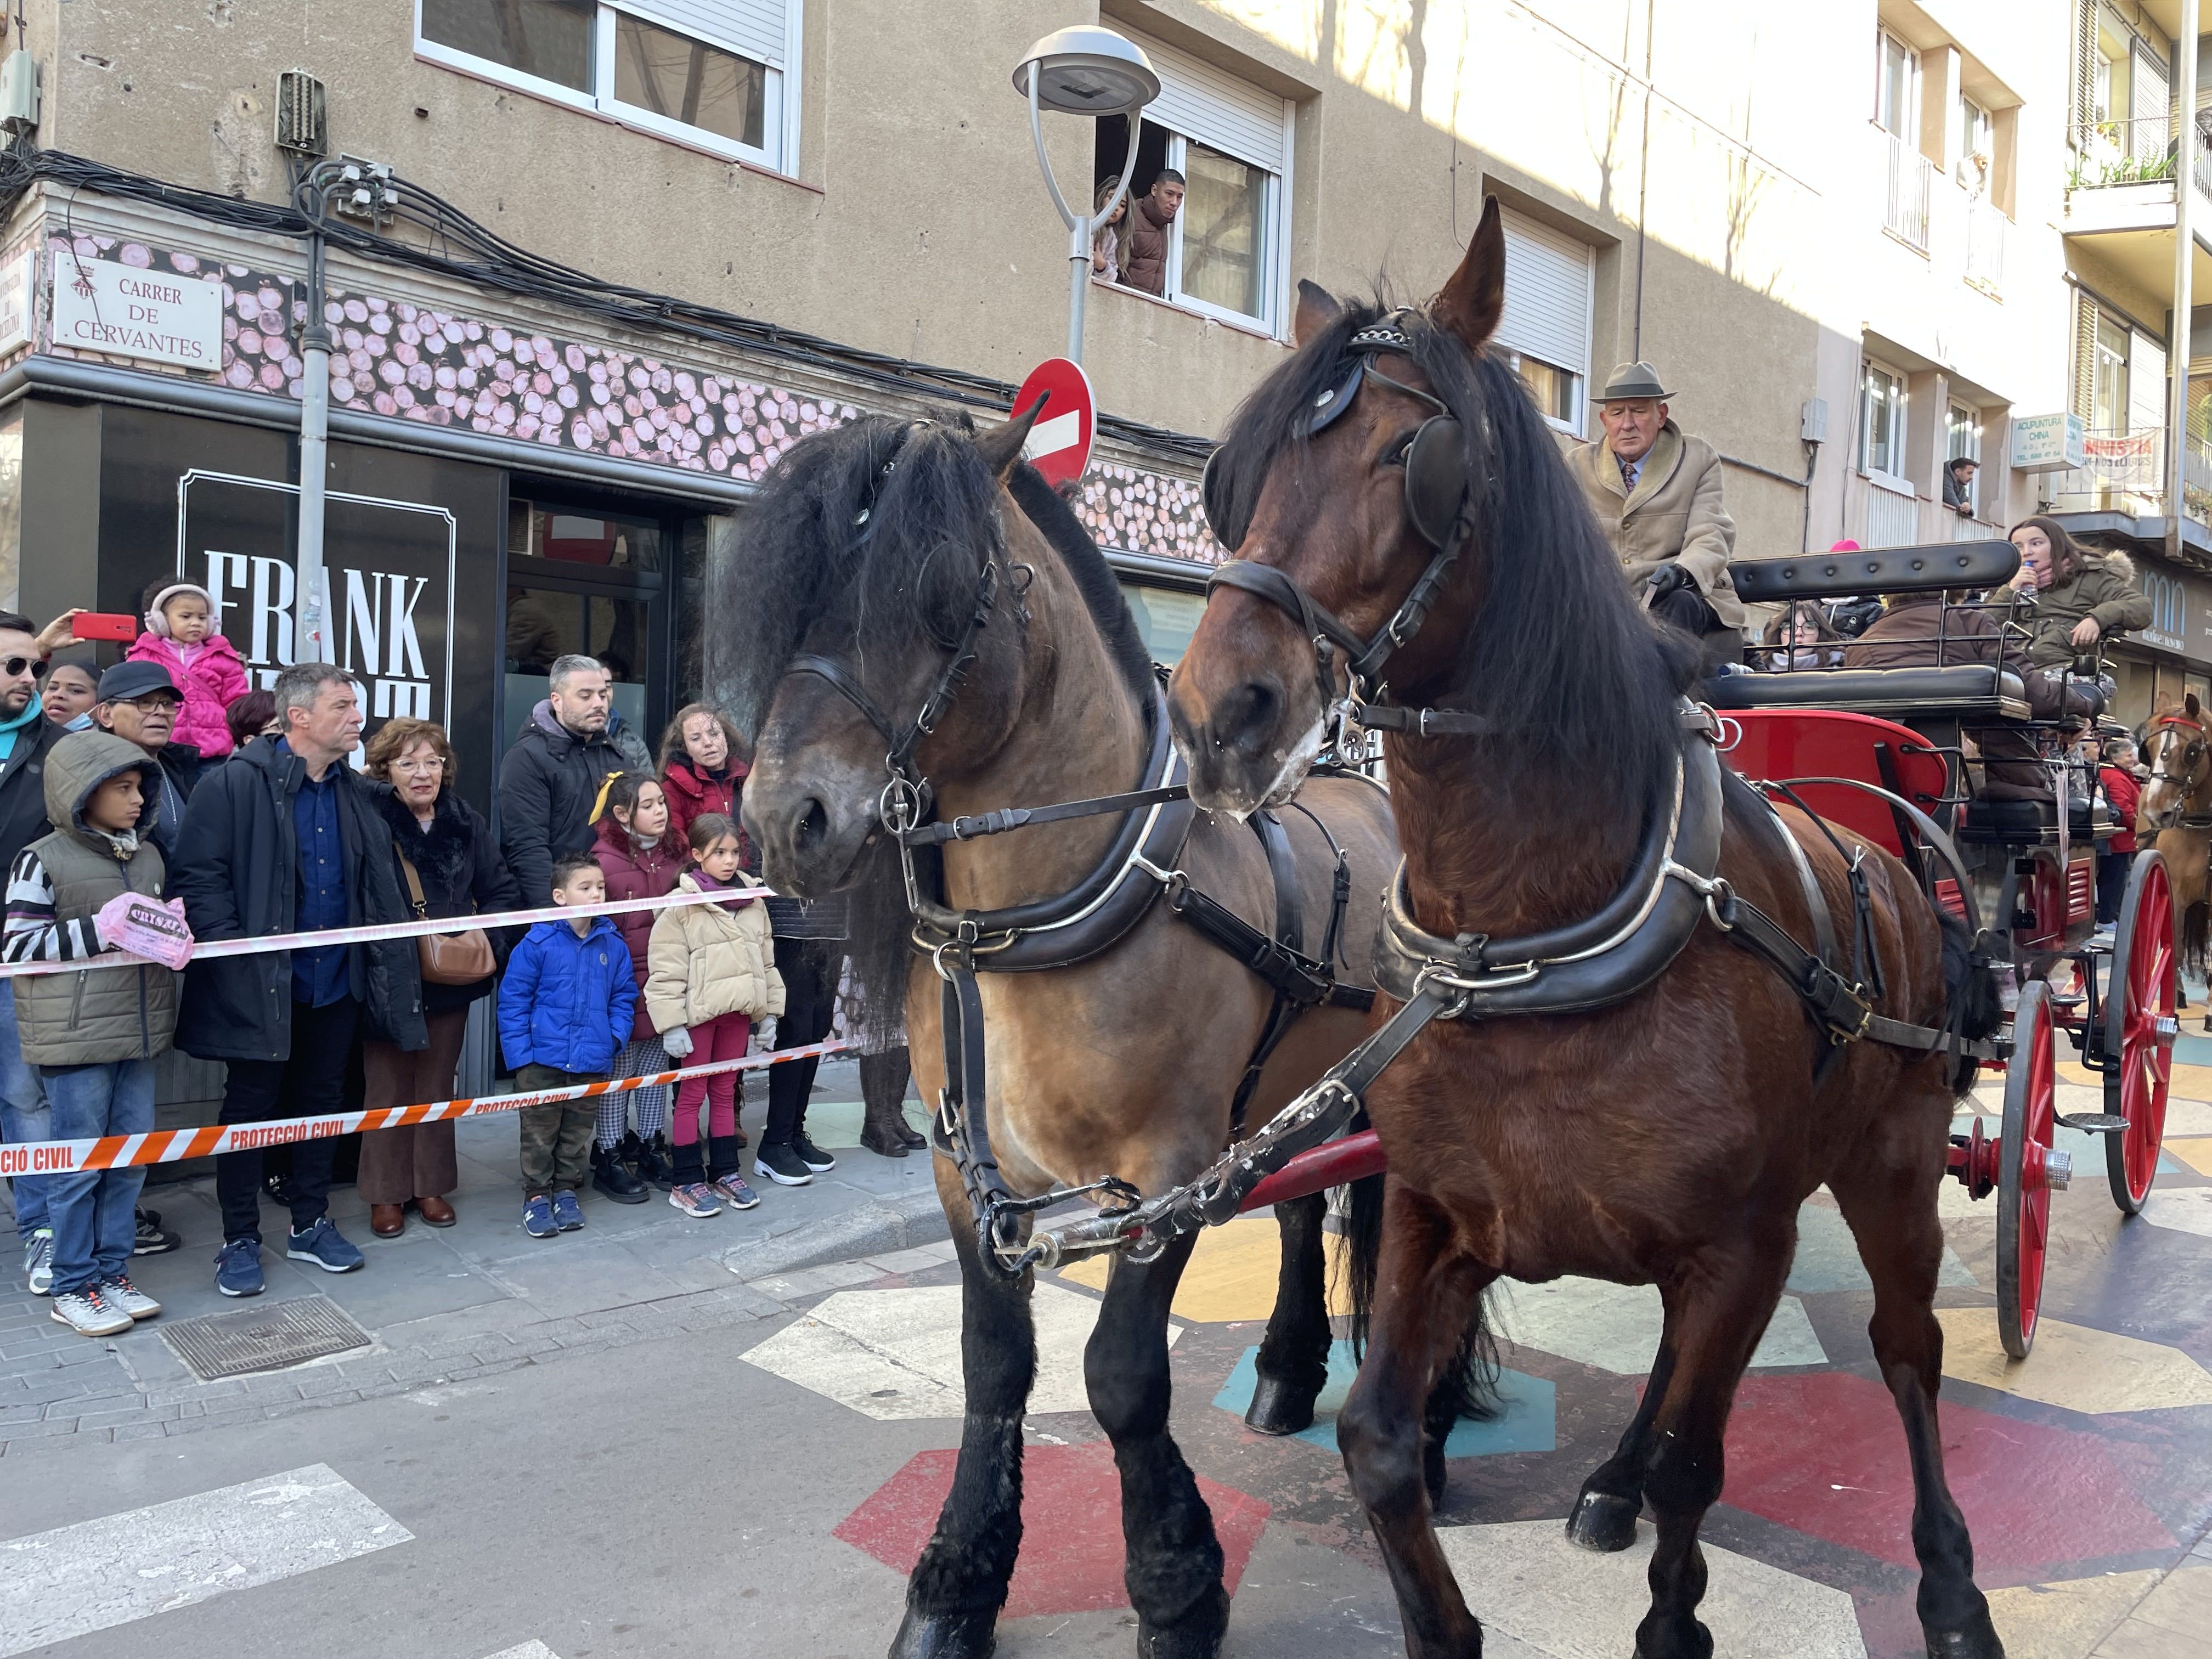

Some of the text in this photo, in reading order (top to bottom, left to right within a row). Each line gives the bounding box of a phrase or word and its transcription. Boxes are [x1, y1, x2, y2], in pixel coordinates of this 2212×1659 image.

[119, 278, 183, 305] CARRER
[128, 304, 159, 325] DE
[74, 319, 203, 359] CERVANTES
[2017, 417, 2062, 431] ACUPUNTURA
[2029, 431, 2050, 441] CHINA
[2083, 438, 2152, 456] MNISTIA
[230, 1120, 307, 1150] PROTECCIÓ
[34, 1146, 74, 1171] CIVIL
